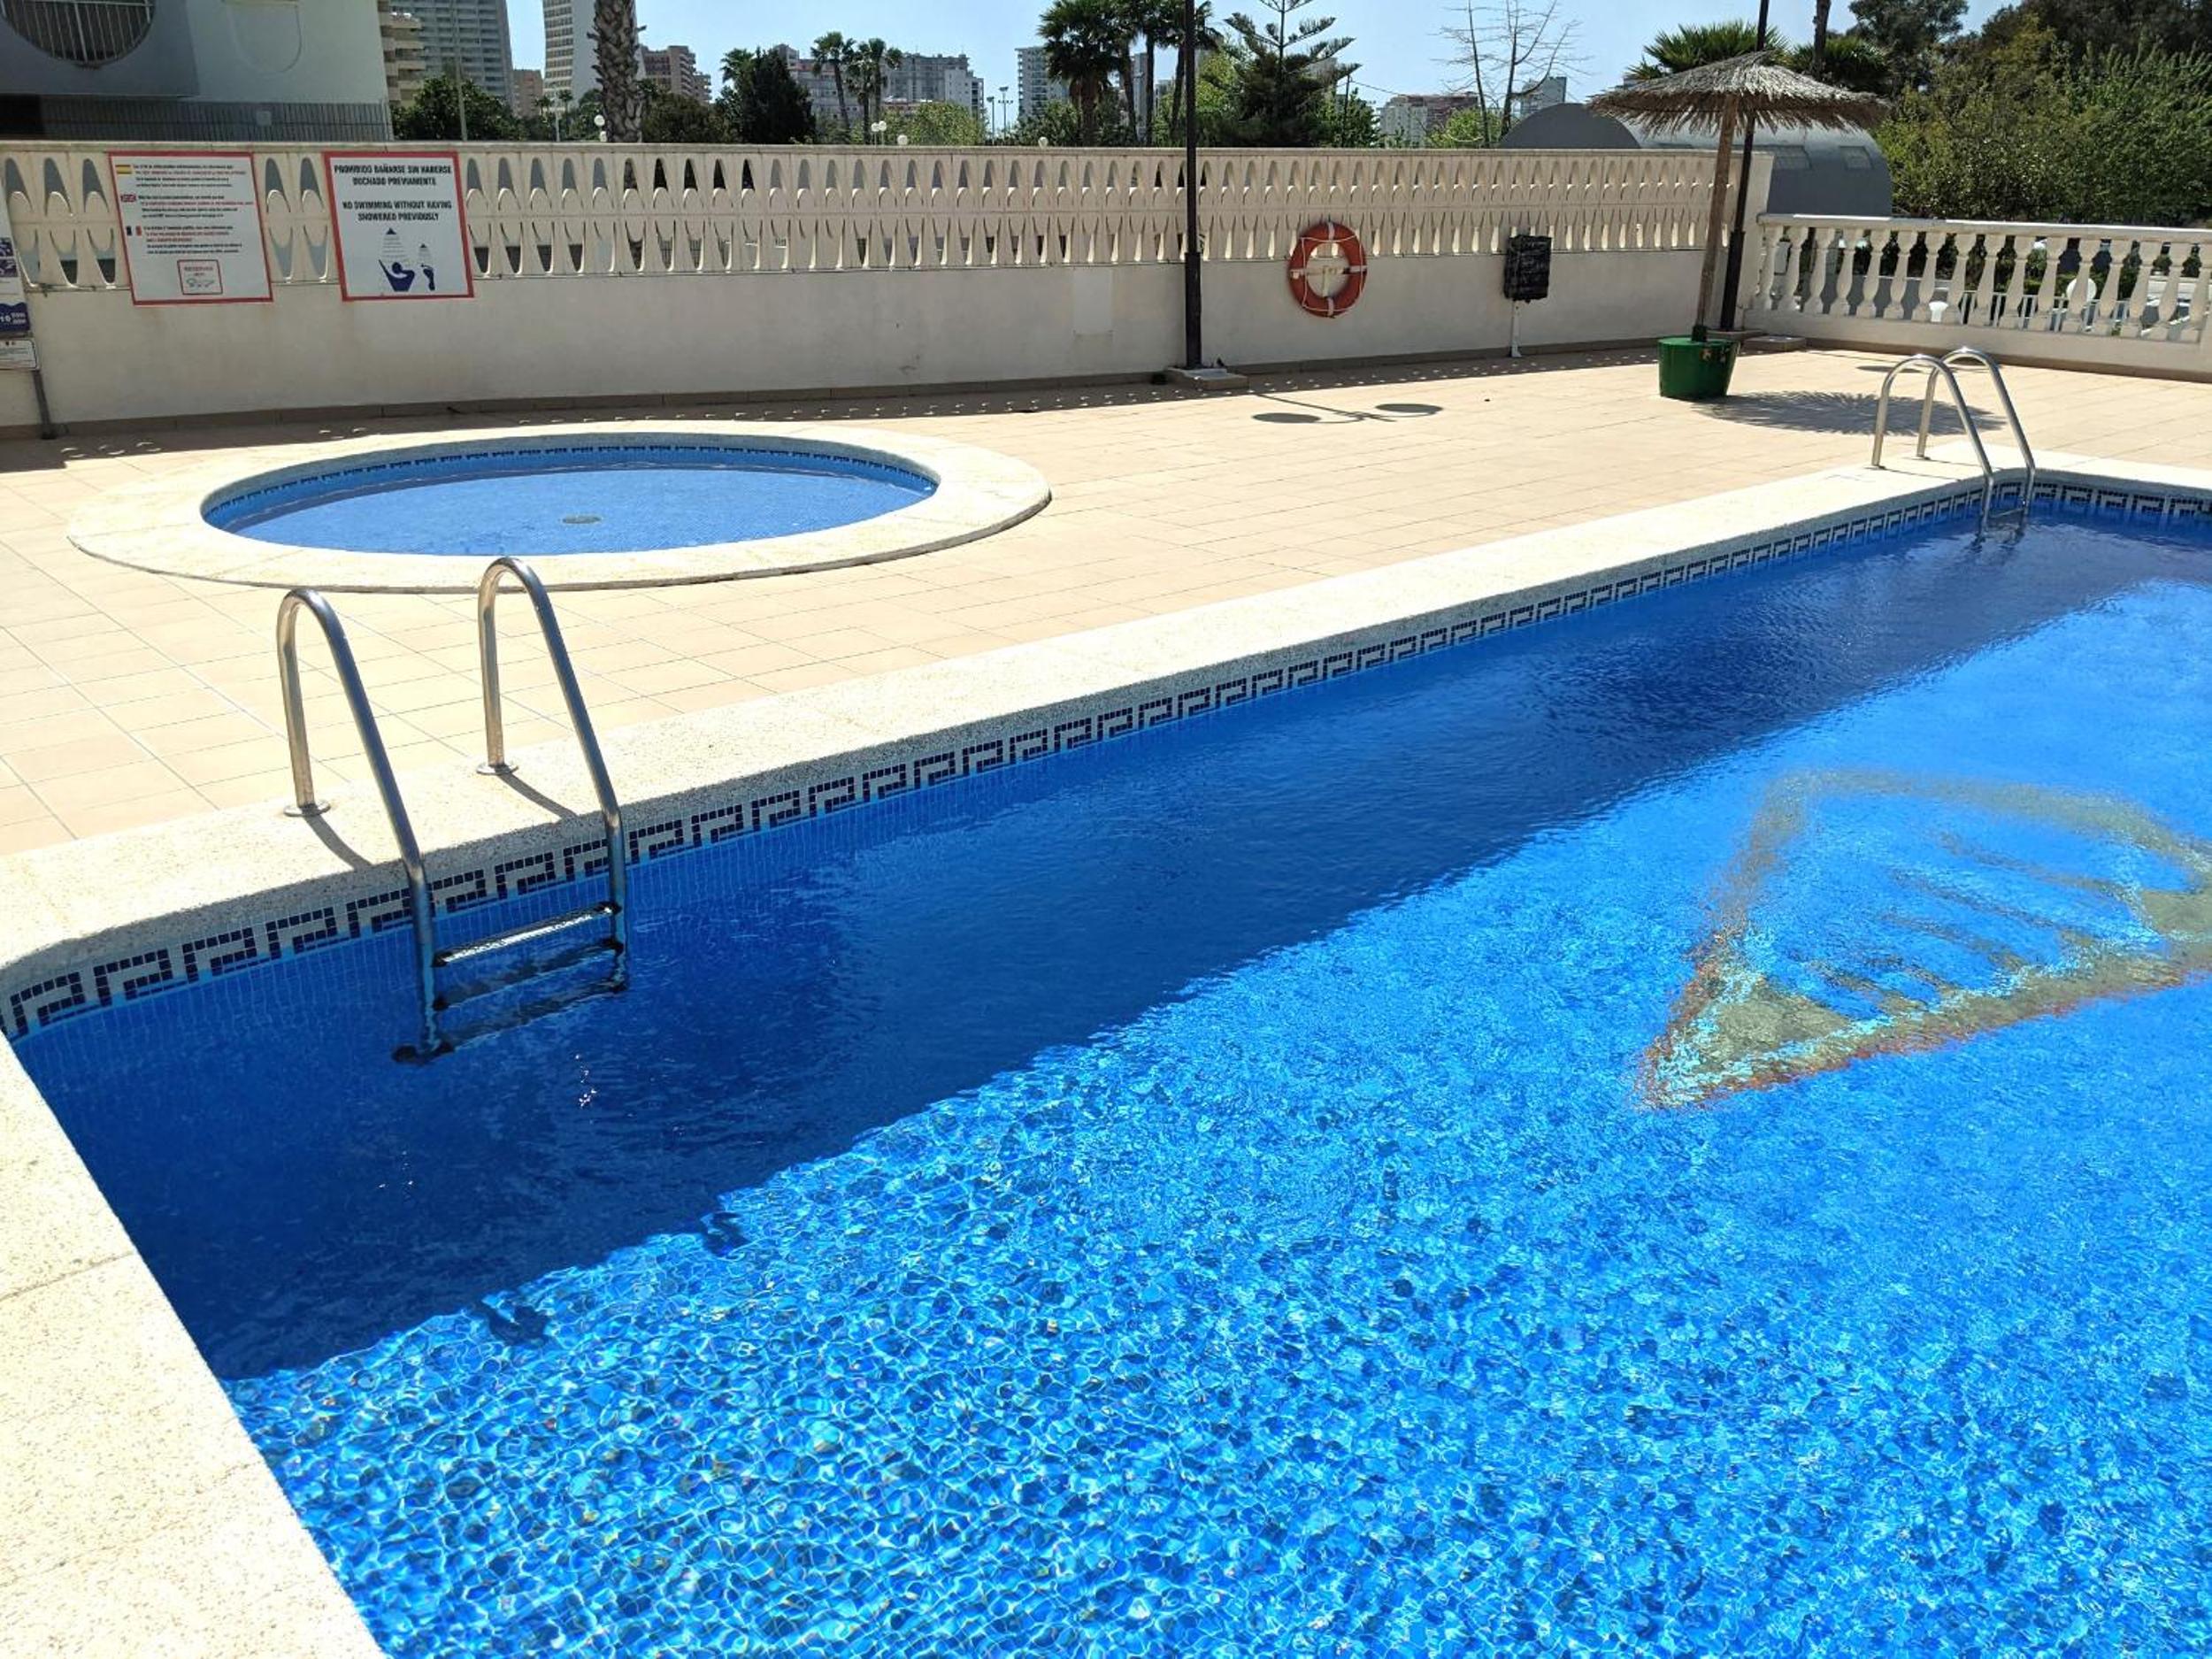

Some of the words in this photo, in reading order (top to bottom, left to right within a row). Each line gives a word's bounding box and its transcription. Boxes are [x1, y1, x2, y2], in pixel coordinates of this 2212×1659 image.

[408, 165, 419, 173] SIN
[388, 177, 436, 186] PREVIAMENTE
[354, 201, 392, 210] SWIMMING
[394, 201, 425, 210] WITHOUT
[426, 201, 452, 210] HAVING
[357, 212, 397, 221] SHOWERED
[398, 212, 439, 221] PREVIOUSLY
